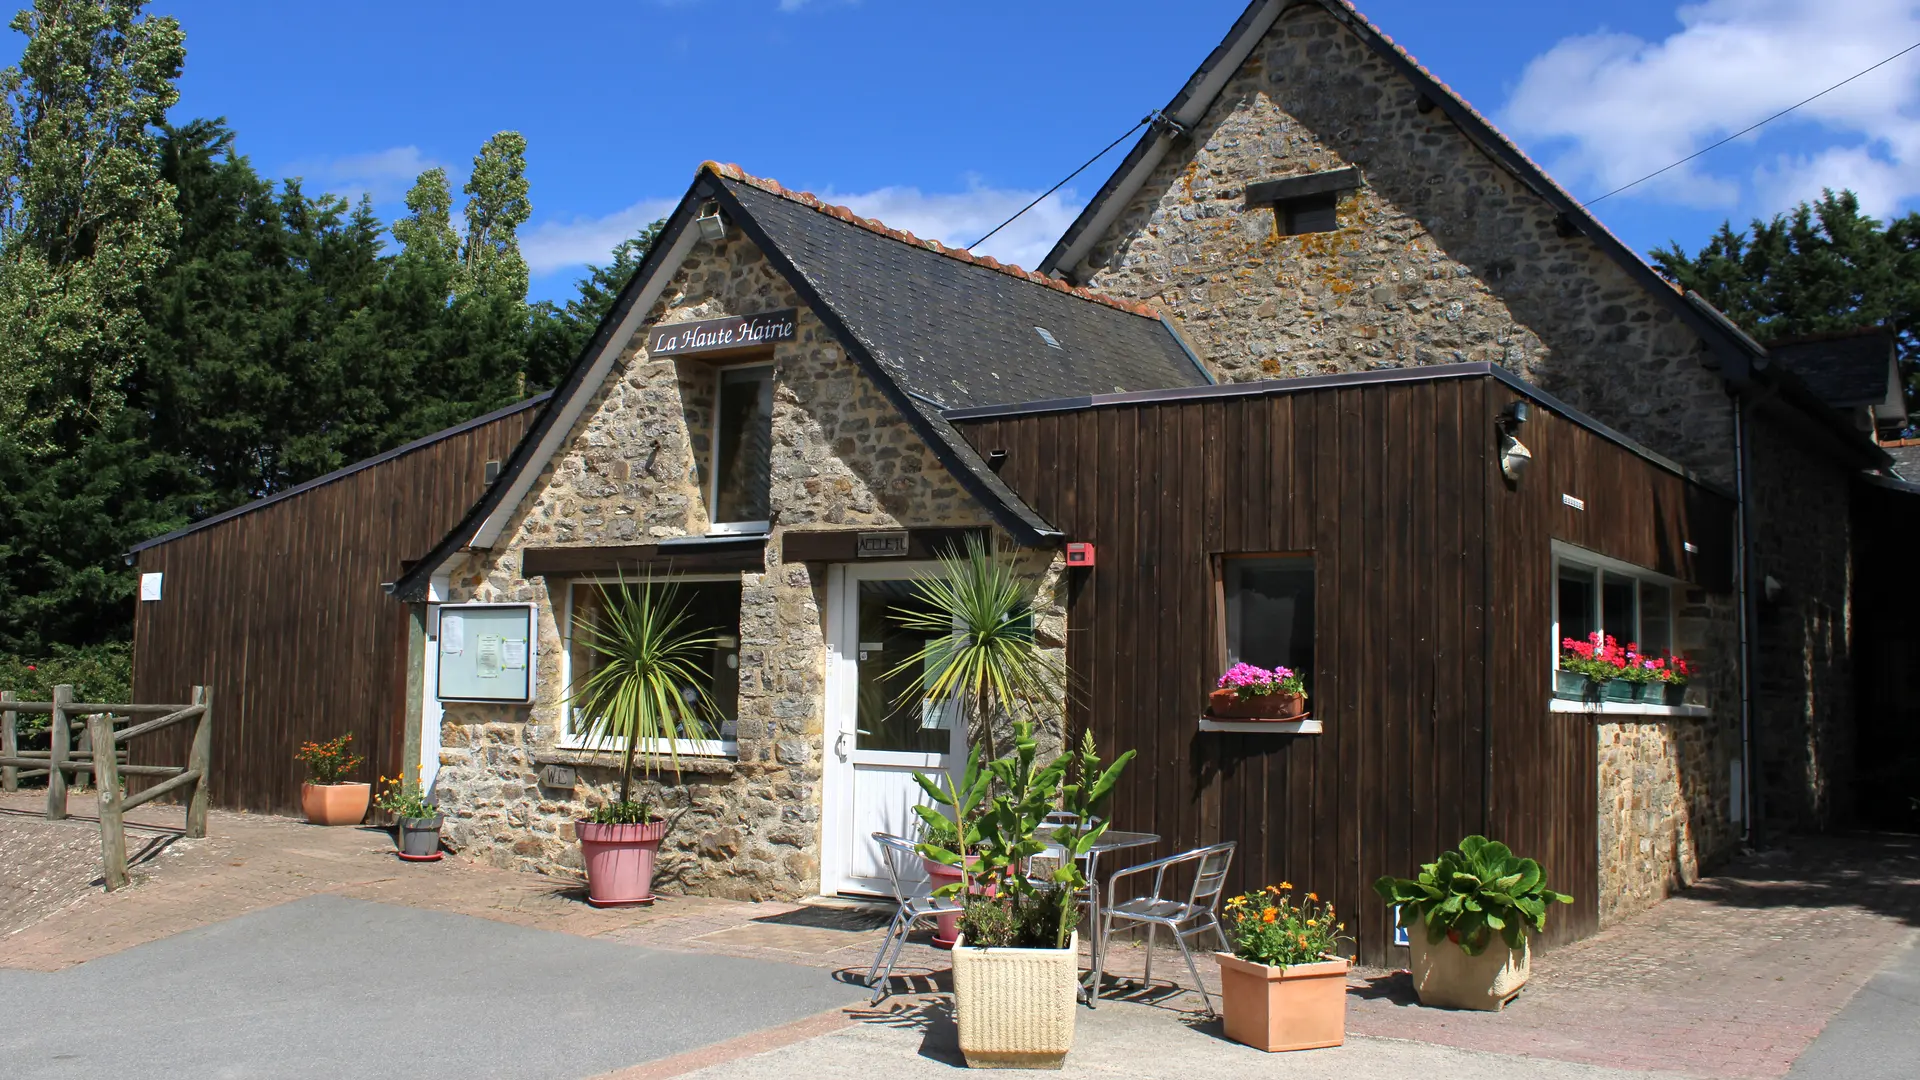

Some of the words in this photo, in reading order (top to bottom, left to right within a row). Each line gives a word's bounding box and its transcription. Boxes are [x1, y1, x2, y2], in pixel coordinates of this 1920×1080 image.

[653, 334, 677, 353] La
[680, 326, 733, 349] Haute
[736, 318, 793, 343] Hairie
